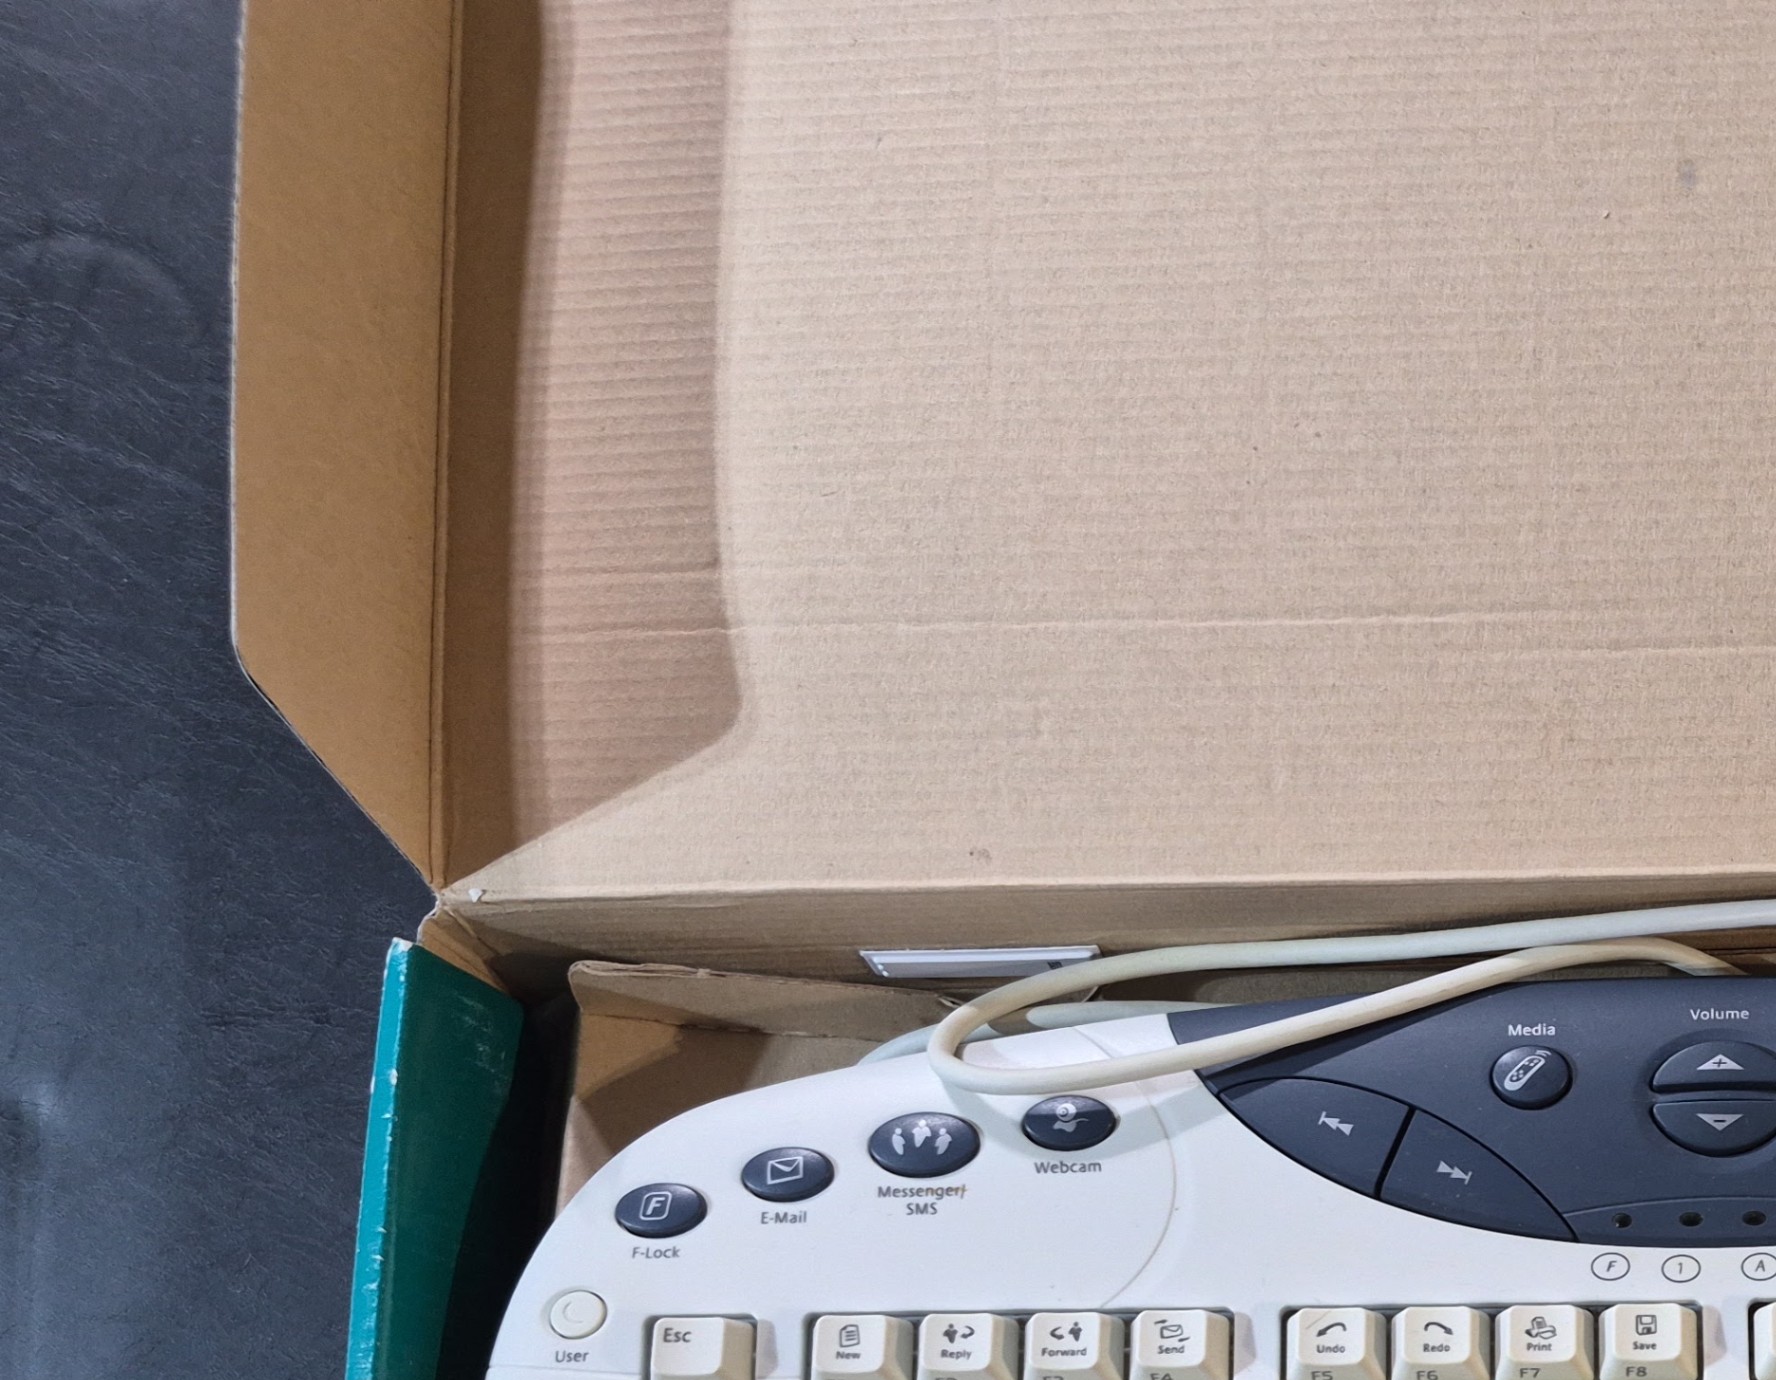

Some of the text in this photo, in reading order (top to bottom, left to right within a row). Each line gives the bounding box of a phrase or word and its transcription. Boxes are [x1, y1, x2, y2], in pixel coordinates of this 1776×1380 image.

[1689, 1007, 1750, 1021] Volume
[1507, 1023, 1556, 1036] Media
[1033, 1159, 1102, 1174] Webcam
[877, 1183, 967, 1201] Messenger/
[906, 1201, 938, 1216] SMS
[760, 1210, 807, 1225] E-Mail
[631, 1245, 680, 1260] F-Lock
[662, 1327, 692, 1344] Esc
[1157, 1344, 1185, 1355] Send
[1315, 1344, 1346, 1354] Undo
[1422, 1342, 1451, 1353] Redo
[1525, 1342, 1553, 1352] Print
[1632, 1340, 1657, 1351] Save
[554, 1350, 590, 1364] User
[835, 1350, 861, 1360] New
[940, 1348, 972, 1360] Reply
[1040, 1346, 1088, 1358] Forward
[1519, 1367, 1541, 1379] F7
[1625, 1366, 1648, 1378] F8
